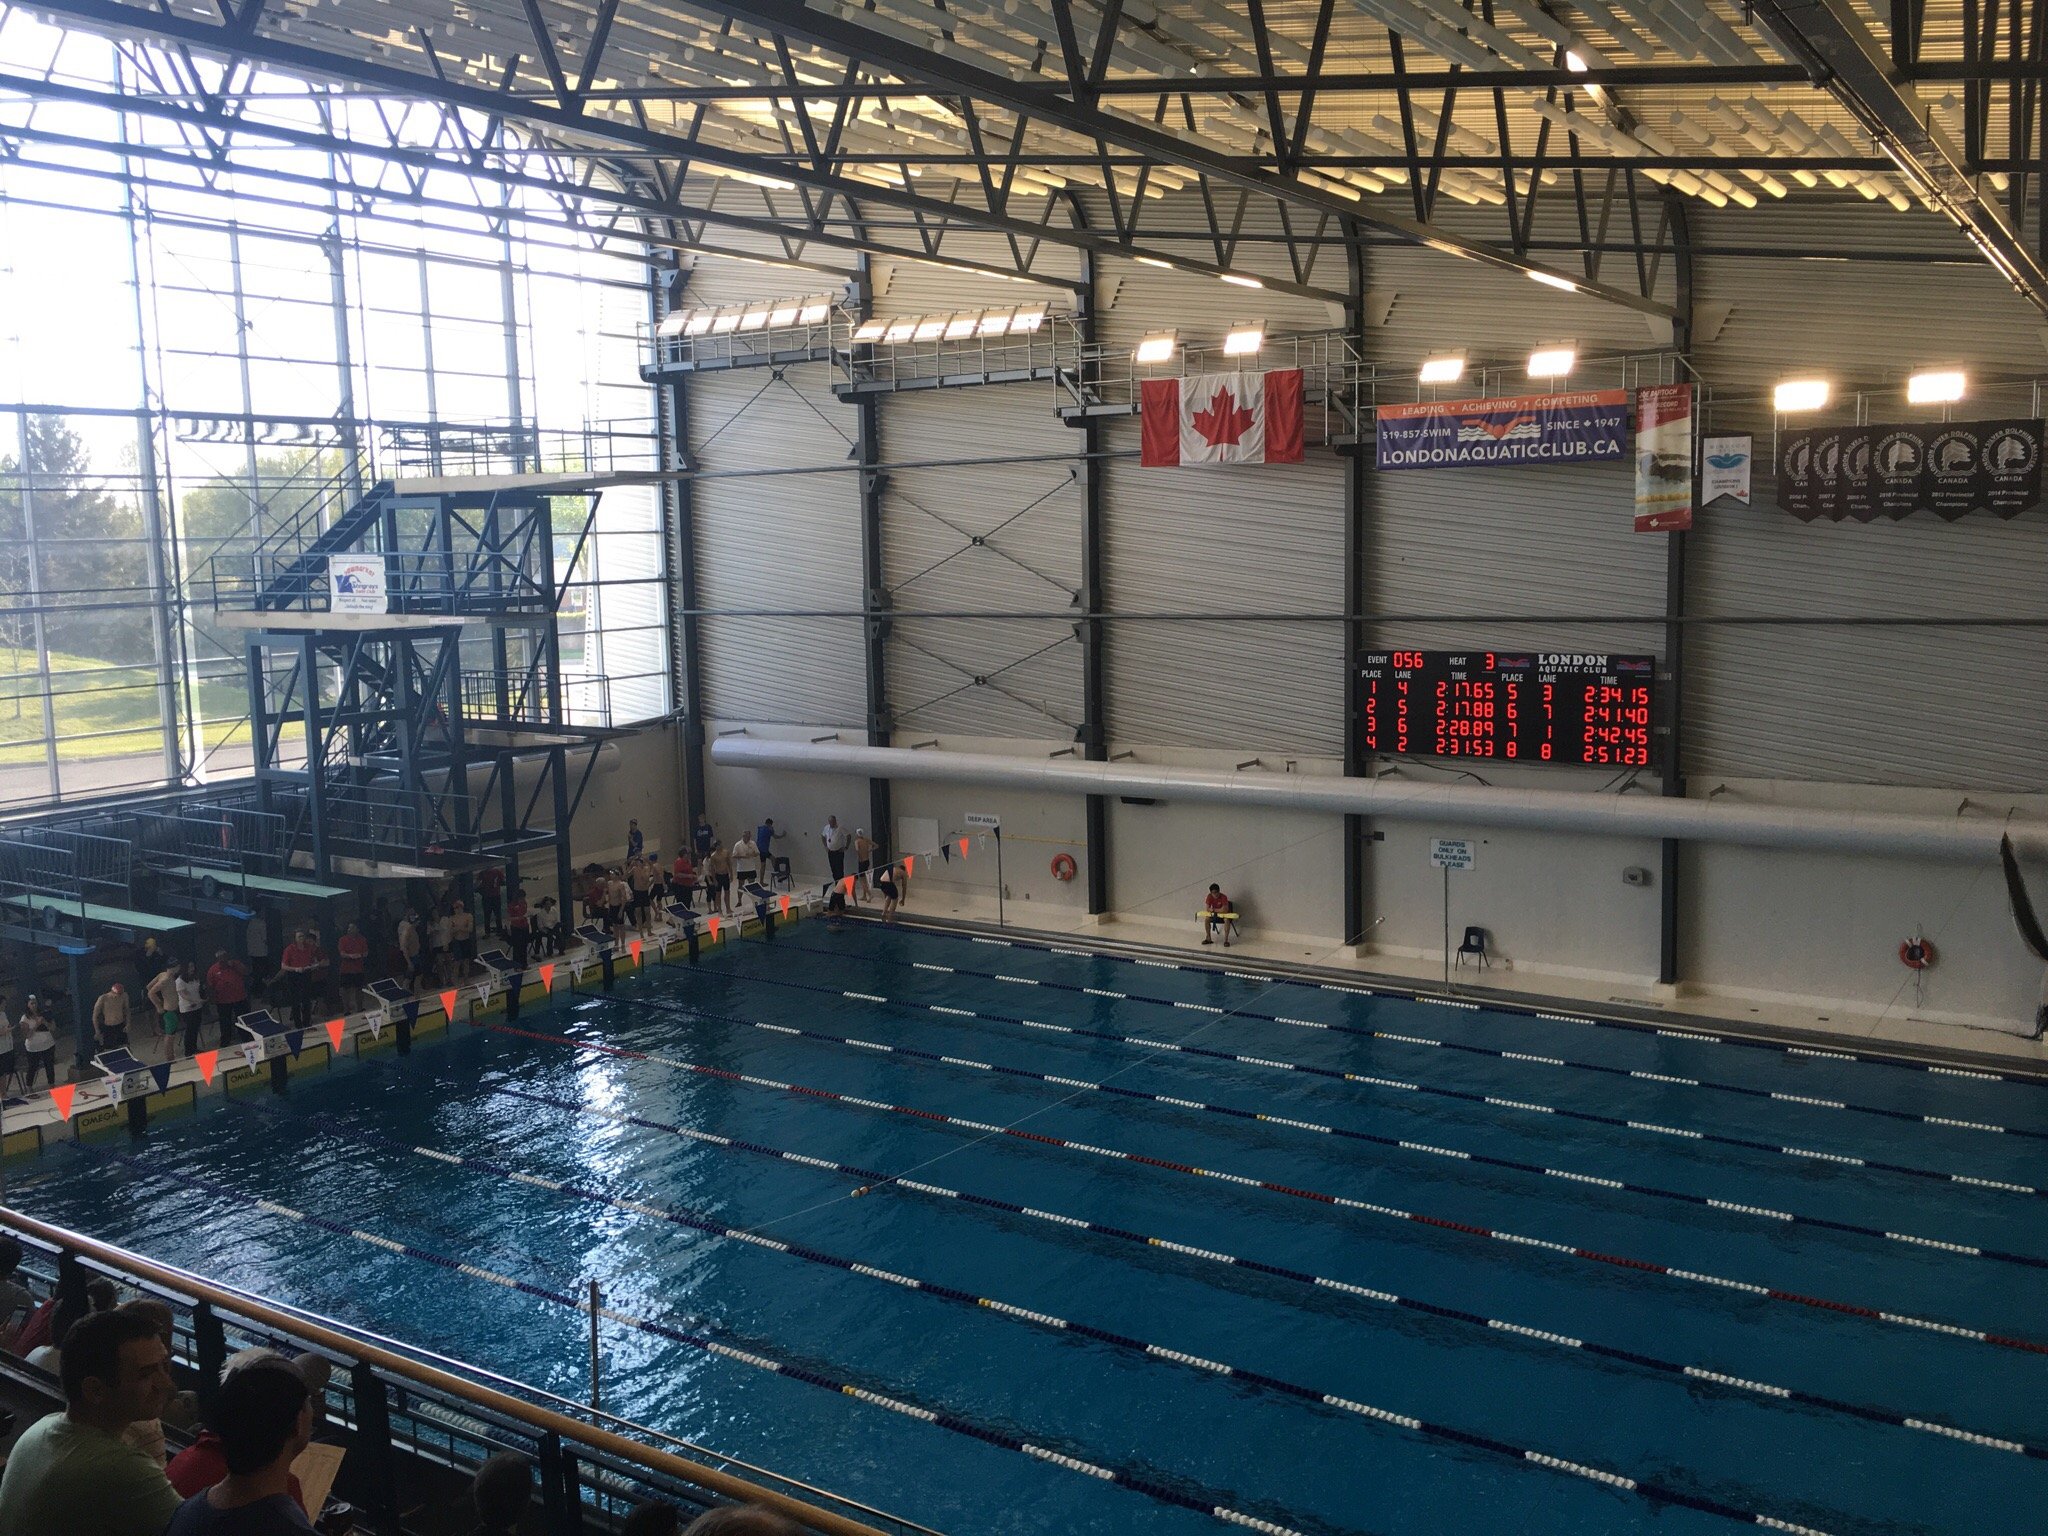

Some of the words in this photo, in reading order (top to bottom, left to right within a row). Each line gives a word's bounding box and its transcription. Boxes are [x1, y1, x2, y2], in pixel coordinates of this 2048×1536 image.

[1402, 405, 1444, 416] LEADING
[1461, 400, 1517, 413] ACHIEVING
[1535, 394, 1598, 407] COMPETING
[1546, 420, 1580, 431] SINCE
[1594, 417, 1621, 428] 1947
[1382, 428, 1451, 440] 519-857-SWIM
[1382, 439, 1620, 465] LONDONAQUATICCLUB.CA
[1367, 656, 1388, 664] EVENT
[1393, 652, 1424, 669] 056
[1449, 657, 1467, 666] HEAT
[1485, 653, 1495, 670] 3
[1538, 654, 1608, 666] LONDON
[1361, 670, 1382, 678] PLACE
[1395, 671, 1412, 679] LANE
[1451, 672, 1467, 680] TIME
[1538, 665, 1579, 673] AQUATIC
[1583, 666, 1608, 674] CLUB
[1501, 673, 1524, 682] PLACE
[1538, 674, 1557, 683] LANE
[1600, 676, 1618, 685] TIME
[1372, 681, 1377, 694] 1
[1397, 681, 1408, 695] 4
[1436, 681, 1494, 699] 2:17.65
[1507, 683, 1518, 700] 5
[1543, 684, 1553, 701] 3
[1584, 685, 1649, 705] 2:34.15
[1366, 698, 1376, 714] 2
[1397, 699, 1408, 715] 5
[1436, 700, 1494, 718] 2:17.88
[1507, 703, 1517, 719] 6
[1543, 704, 1552, 720] 7
[1584, 705, 1648, 725] 2:41.40
[1367, 716, 1376, 732] 3
[1397, 718, 1408, 733] 6
[1436, 719, 1494, 737] 2:28.89
[1508, 722, 1517, 738] 7
[1547, 725, 1552, 739] 1
[1583, 726, 1648, 745] 2:42.45
[1366, 735, 1376, 749] 4
[1397, 736, 1408, 752] 2
[1436, 738, 1494, 756] 2:31.53
[1506, 741, 1517, 758] 8
[1541, 743, 1552, 760] 8
[1583, 745, 1647, 765] 2:51.23
[1433, 853, 1471, 861] BULKHEADS
[493, 973, 498, 983] 5
[127, 1077, 134, 1089] 2
[82, 1110, 119, 1127] OMEGA
